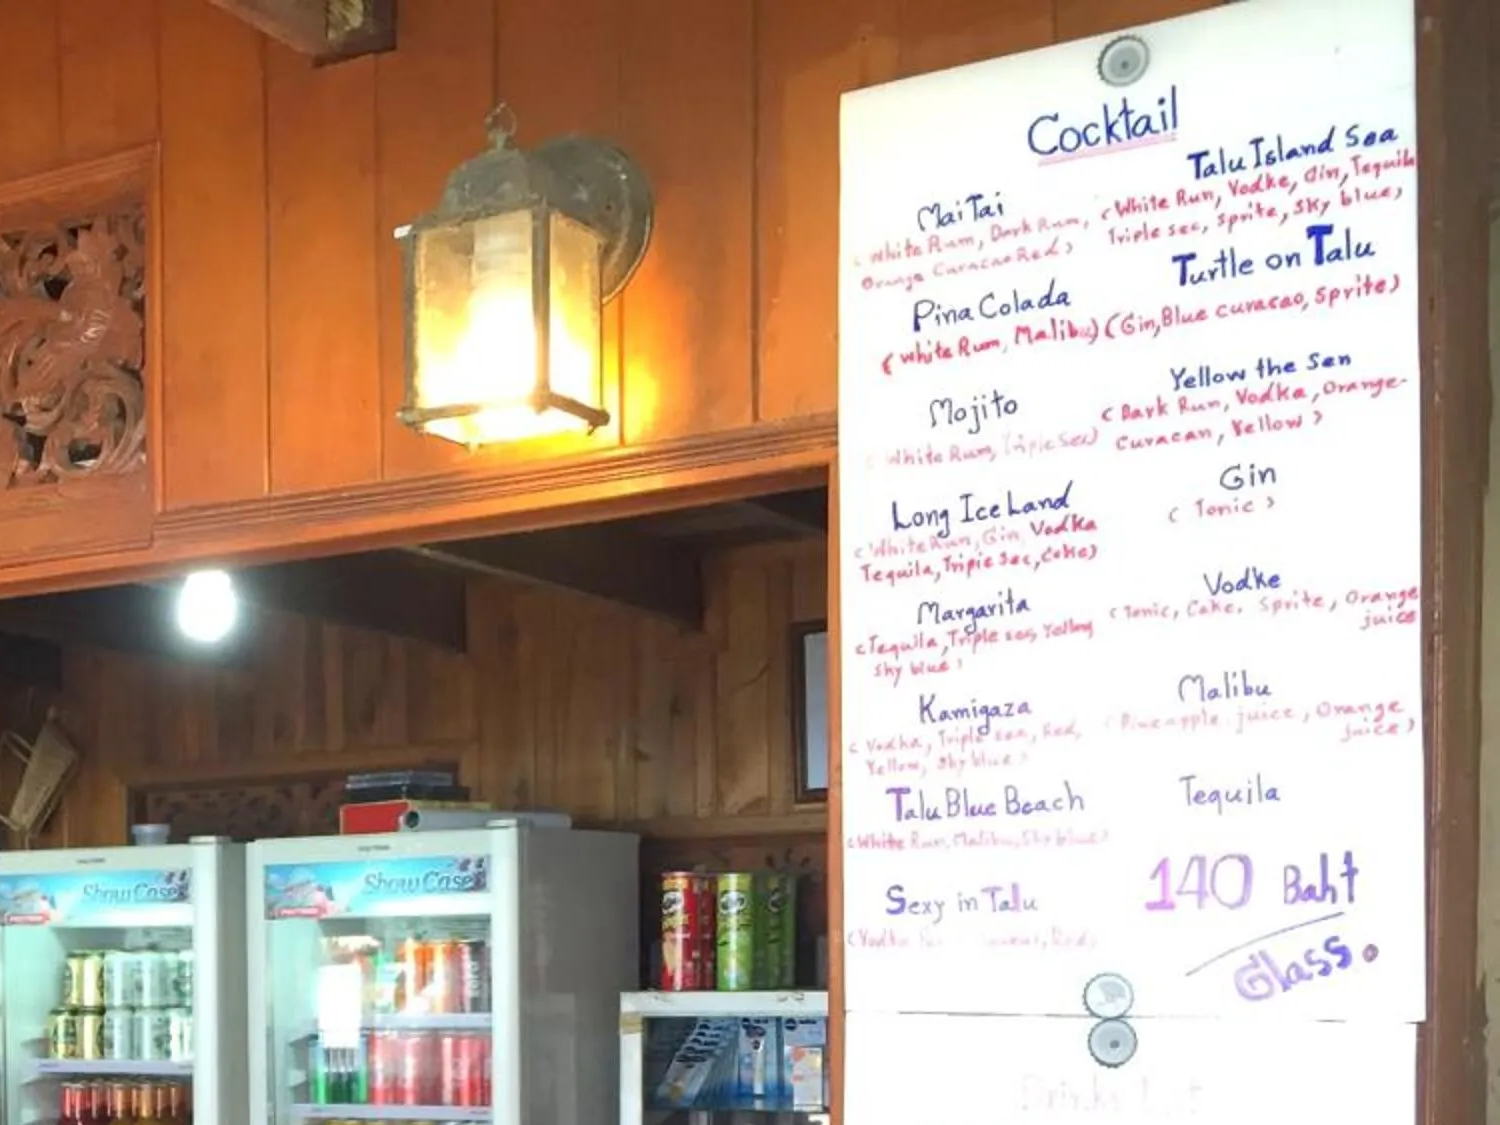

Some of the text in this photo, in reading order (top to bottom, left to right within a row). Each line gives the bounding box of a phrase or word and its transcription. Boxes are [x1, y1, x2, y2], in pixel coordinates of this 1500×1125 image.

[1026, 84, 1178, 156] Cocktail
[1171, 223, 1376, 286] Turtle on Talu
[1170, 366, 1246, 391] Yellow
[1256, 357, 1297, 380] the
[929, 389, 1019, 435] Mojito
[1219, 463, 1277, 491] Gin
[891, 500, 951, 539] Long
[916, 587, 1032, 636] Margarita
[1178, 670, 1272, 702] Malibu
[918, 692, 1033, 737] Kamigaza
[885, 780, 1086, 822] Talu Blue Beach
[1178, 772, 1282, 816] Tequila
[1144, 850, 1360, 912] 140 Baht
[885, 882, 1039, 925] Sexy in Talu
